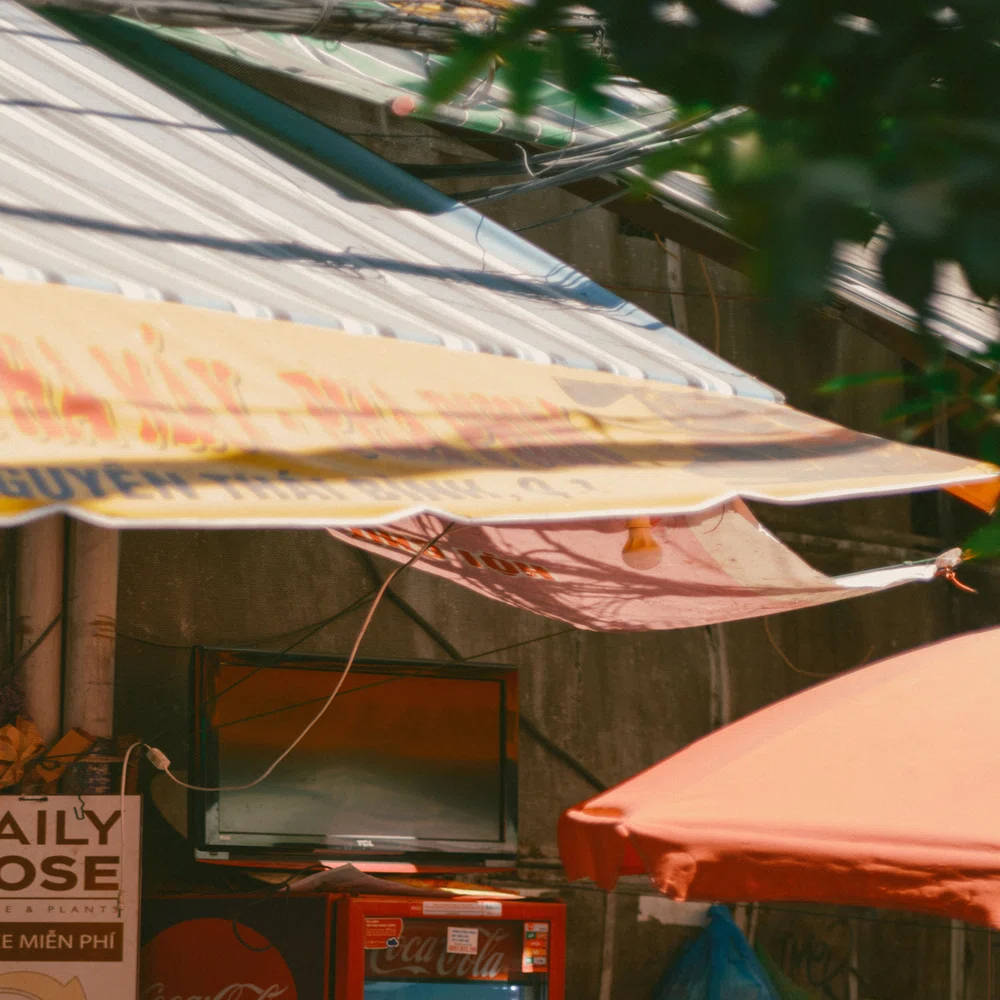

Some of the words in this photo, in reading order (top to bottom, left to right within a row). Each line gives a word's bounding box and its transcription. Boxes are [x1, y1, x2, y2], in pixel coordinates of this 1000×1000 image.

[26, 905, 33, 913] &
[47, 905, 120, 914] PLANTS
[19, 930, 73, 950] MIỄN
[80, 931, 115, 949] PHÍ
